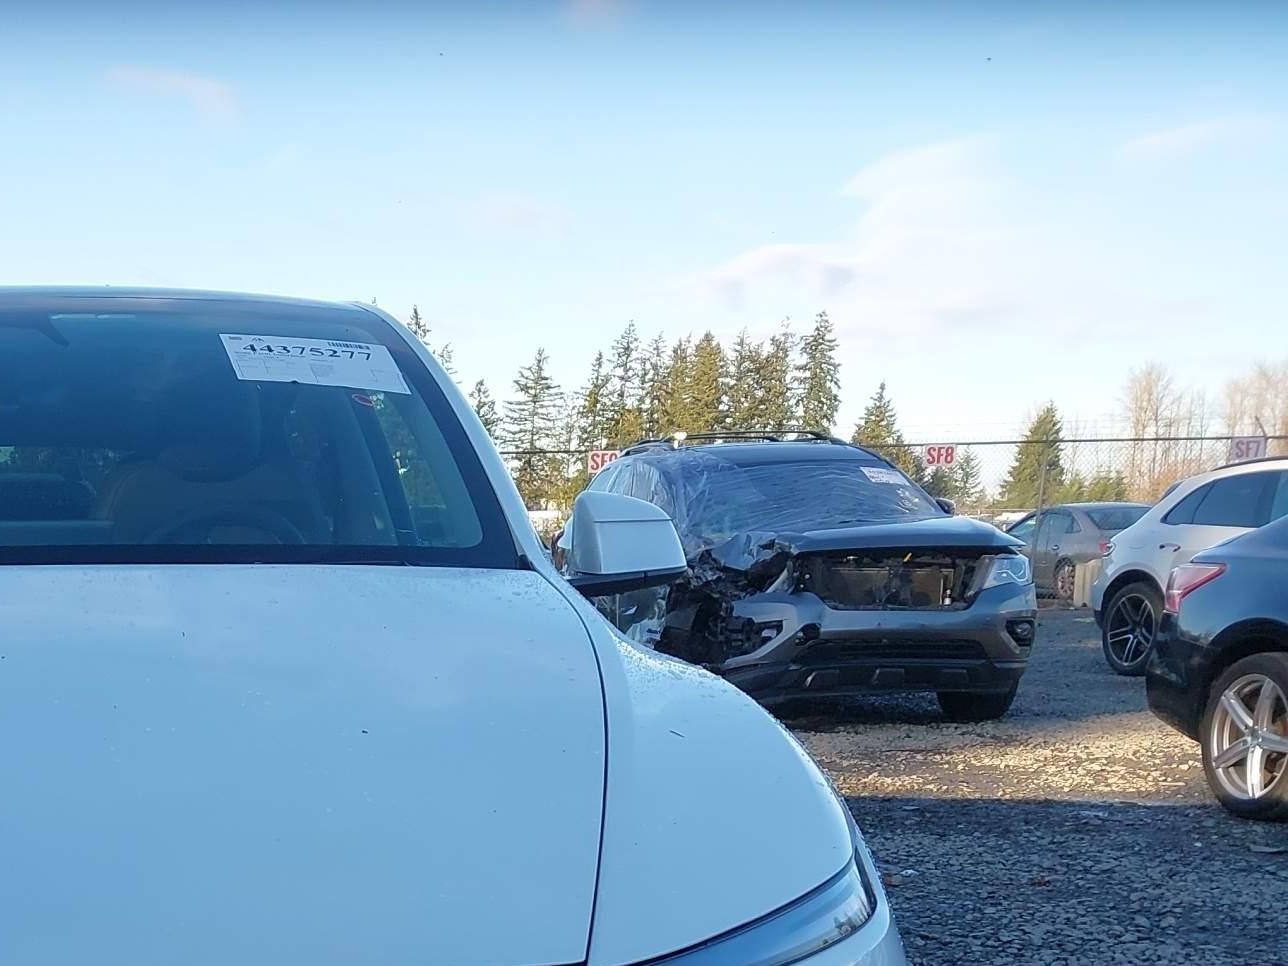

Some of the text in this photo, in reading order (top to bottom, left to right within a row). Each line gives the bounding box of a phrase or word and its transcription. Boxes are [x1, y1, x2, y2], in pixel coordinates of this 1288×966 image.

[243, 343, 372, 361] 44375277
[926, 446, 954, 464] SF8
[1235, 440, 1260, 458] SF7
